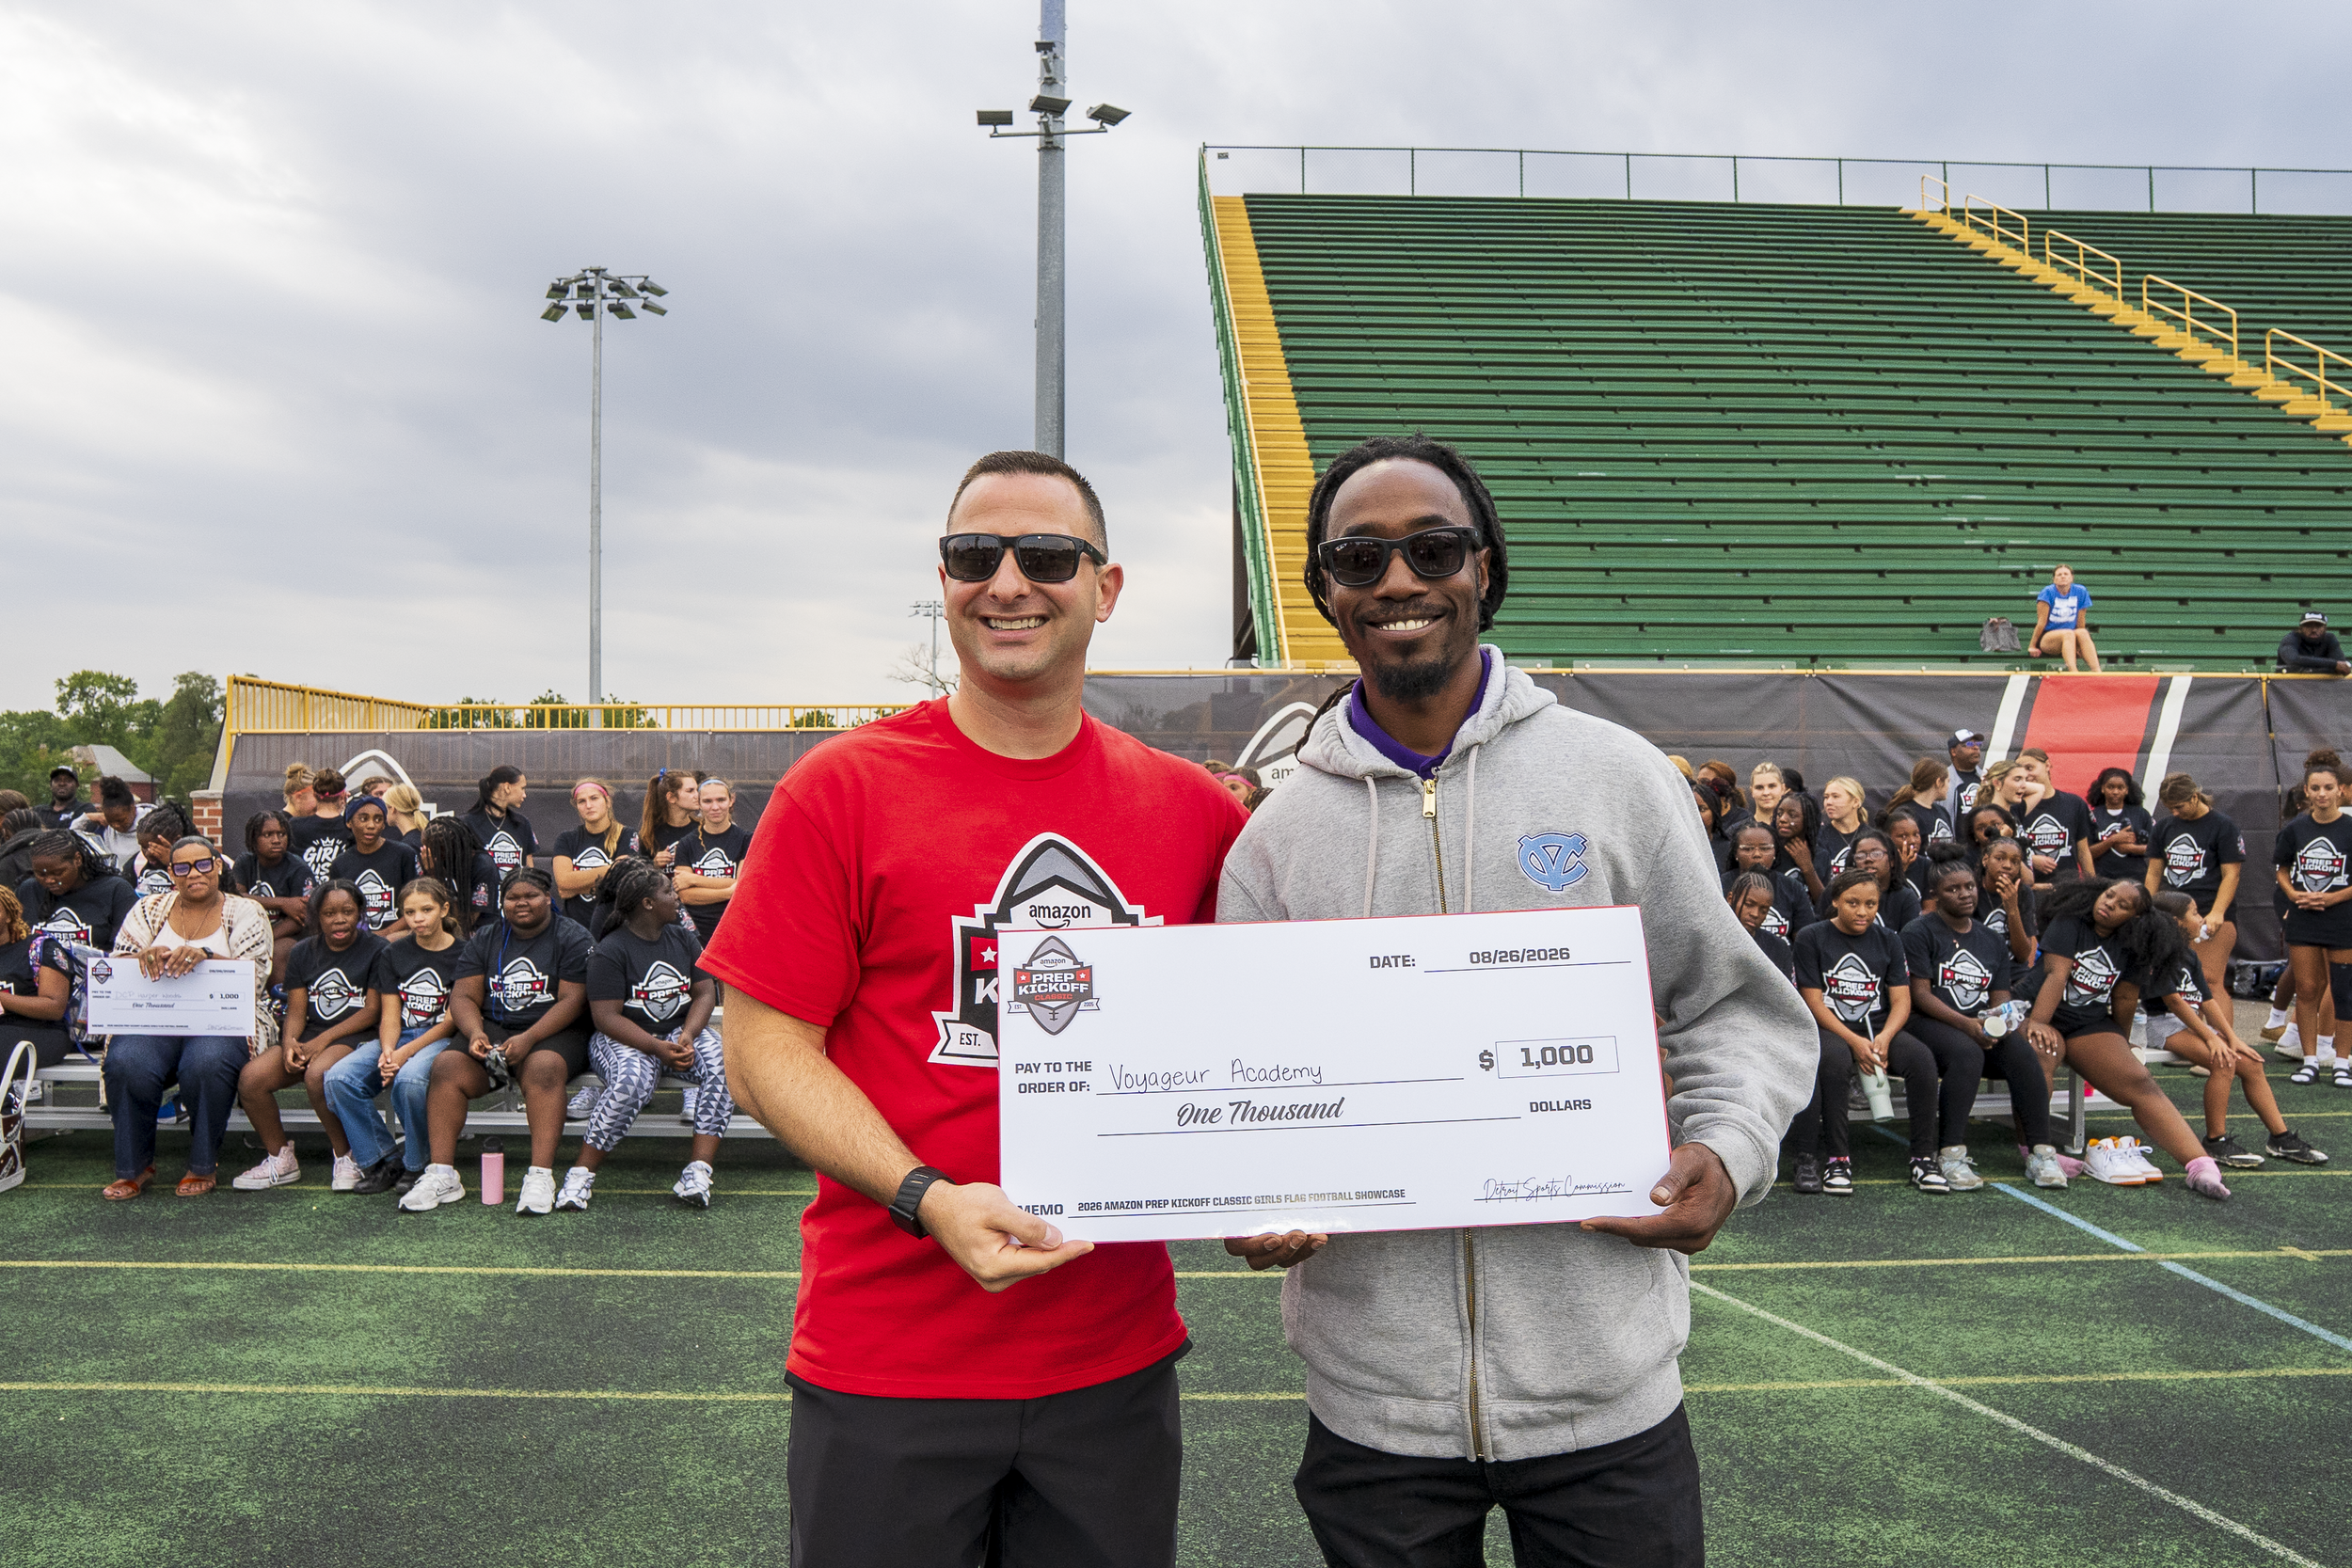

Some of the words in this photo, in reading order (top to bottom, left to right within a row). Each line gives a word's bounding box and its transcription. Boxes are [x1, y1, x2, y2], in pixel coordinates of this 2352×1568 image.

[1028, 904, 1091, 920] amazon
[1369, 954, 1416, 969] DATE:
[1469, 947, 1570, 964] 08/26/2026
[1032, 973, 1075, 984] PREP
[2077, 966, 2106, 983] PREP
[1018, 983, 1089, 996] KICKOFF
[1831, 986, 1876, 998] KICKOFF
[1837, 980, 1866, 990] PREP
[408, 994, 437, 1004] PREP
[960, 1033, 981, 1047] EST.
[1478, 1049, 1495, 1071] $
[1520, 1044, 1594, 1069] 1,000
[1015, 1062, 1041, 1074] PAY
[1044, 1061, 1062, 1073] TO
[1066, 1060, 1092, 1072] THE
[1109, 1064, 1210, 1094] Voyageur
[1232, 1058, 1323, 1084] Academy
[1018, 1081, 1065, 1094] ORDER
[1069, 1080, 1090, 1092] OF:
[1177, 1102, 1223, 1127] One
[1229, 1096, 1345, 1125] Thousand
[1529, 1099, 1592, 1113] DOLLARS
[1523, 1177, 1564, 1202] Sports
[1565, 1175, 1626, 1197] Commission
[1077, 1200, 1103, 1212] 2026
[1104, 1199, 1143, 1211] AMAZON
[1145, 1198, 1169, 1209] PREP
[1171, 1197, 1211, 1209] KICKOFF
[1213, 1196, 1252, 1207] CLASSIC
[1254, 1195, 1282, 1205] GIRLS
[1284, 1193, 1307, 1204] FLAG
[1309, 1191, 1353, 1203] FOOTBALL
[1355, 1189, 1406, 1201] SHOWCASE
